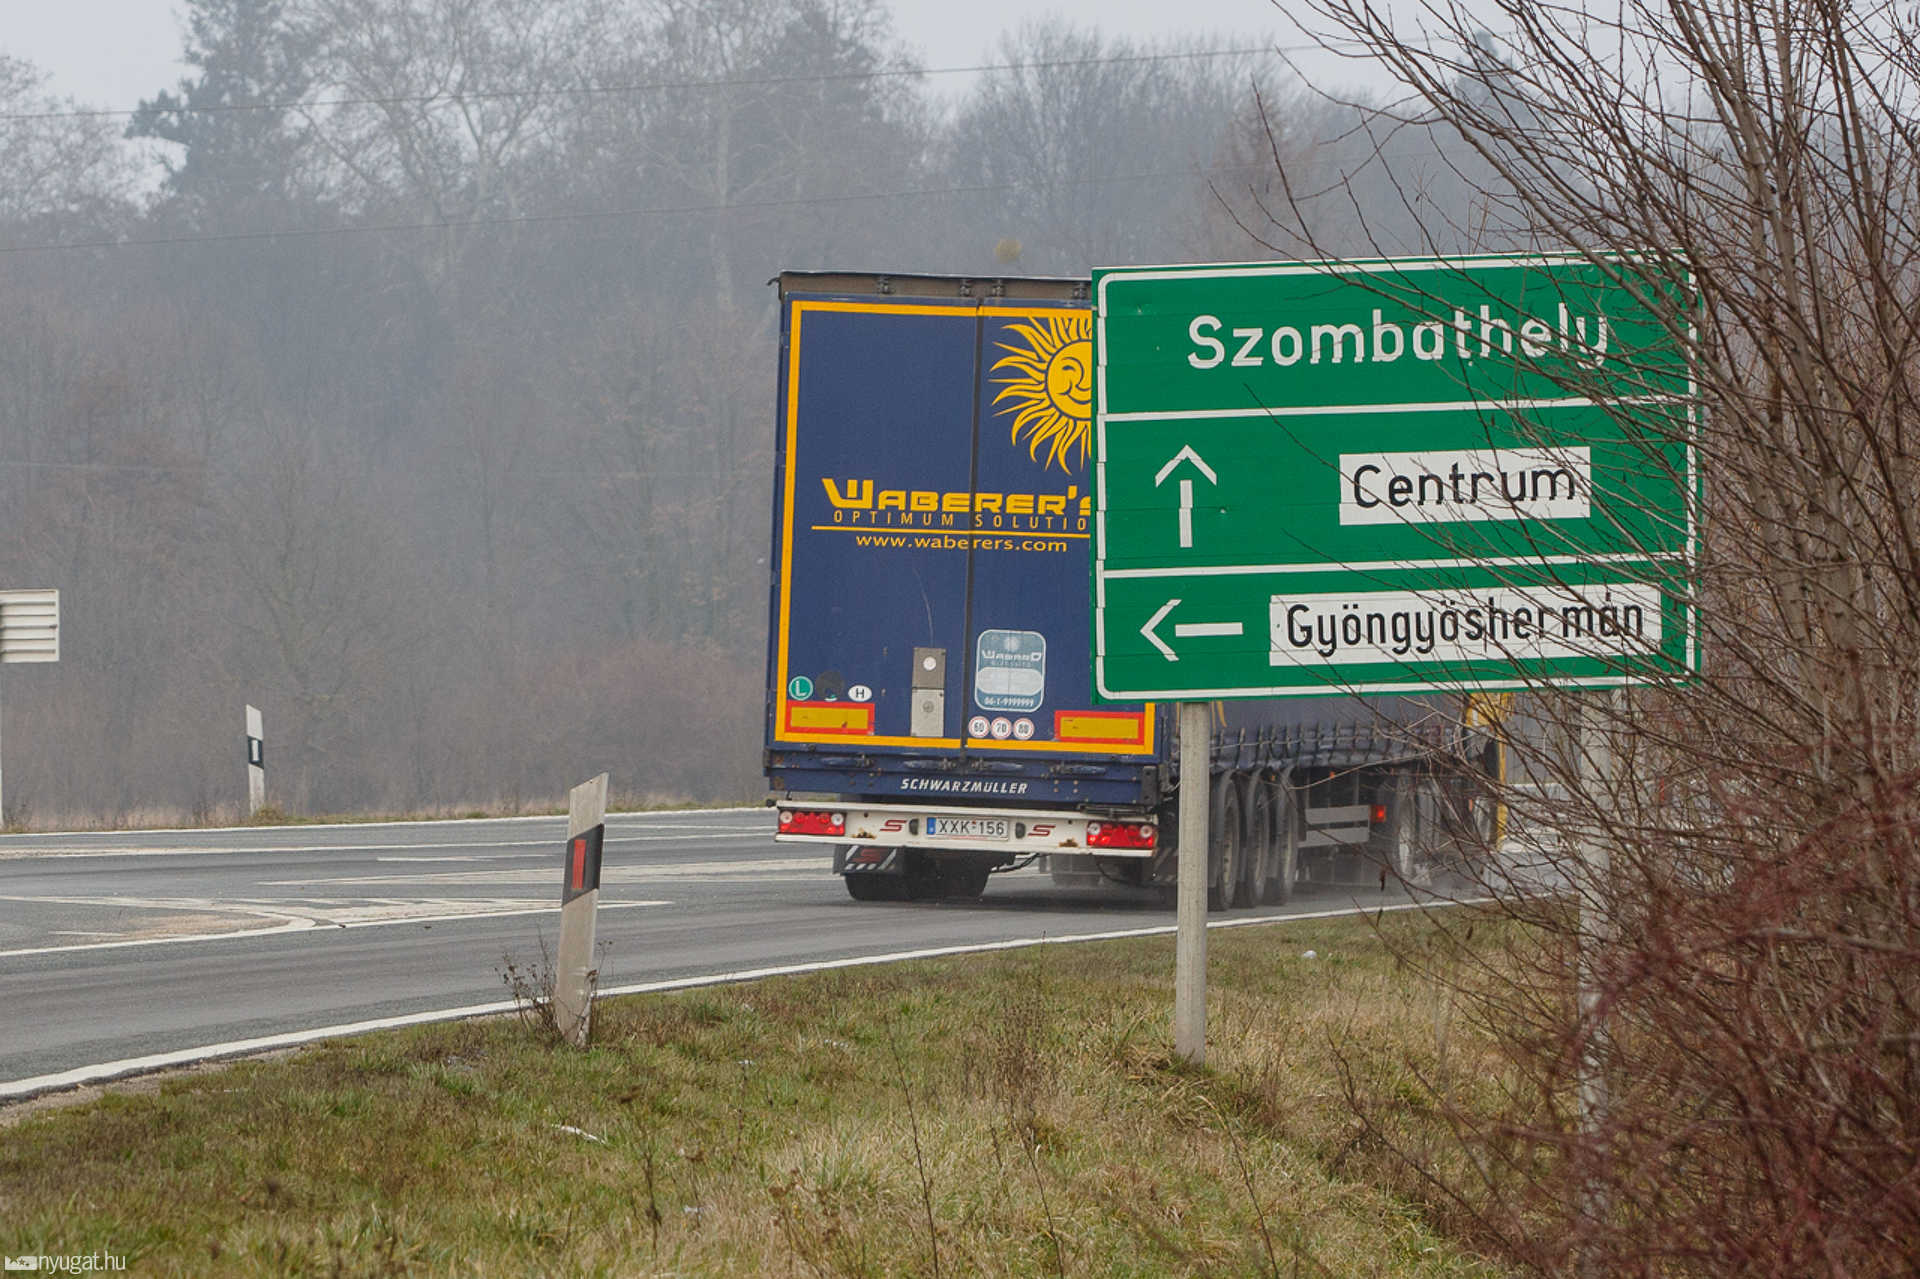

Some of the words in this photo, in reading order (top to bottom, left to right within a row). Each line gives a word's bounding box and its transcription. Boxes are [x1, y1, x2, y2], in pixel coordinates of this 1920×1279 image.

[1187, 302, 1608, 370] Szombathely
[1353, 461, 1577, 509] Centrum
[833, 509, 955, 526] OPTIMUM
[975, 513, 1087, 531] SOLUTIO
[856, 534, 1067, 552] www.waberers.com
[1287, 592, 1643, 658] Gyöngyöshermán
[795, 680, 808, 697] L
[855, 687, 865, 699] H
[995, 722, 1007, 734] 70
